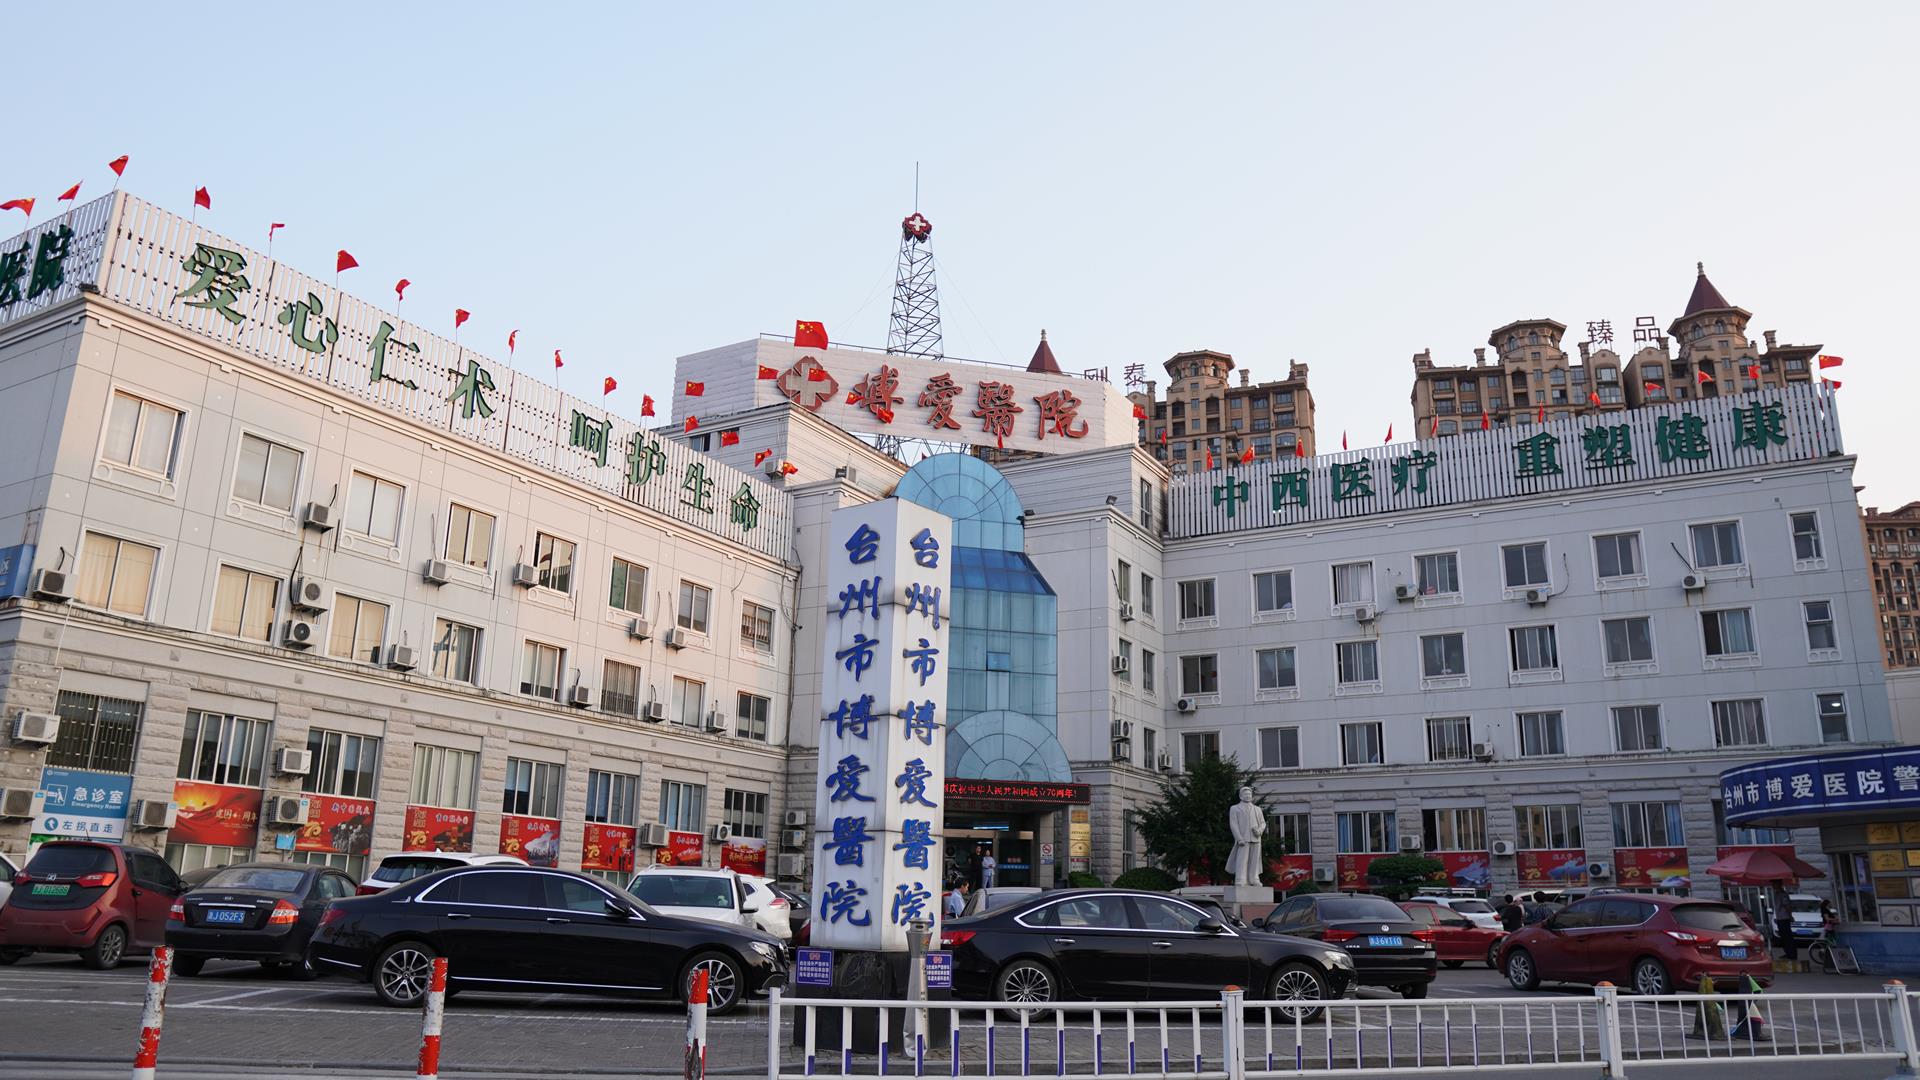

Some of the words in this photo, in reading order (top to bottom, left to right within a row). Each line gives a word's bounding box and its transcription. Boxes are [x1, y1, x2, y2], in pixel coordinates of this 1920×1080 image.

[1586, 316, 1661, 344] 臻品
[176, 242, 496, 419] 爱心仁术
[569, 409, 761, 532] 呵护生命
[1213, 449, 1437, 518] 中西医疗
[1513, 401, 1788, 476] 重塑健康
[73, 786, 124, 804] 急诊室
[1724, 765, 1920, 809] 台州市博爱医院警
[71, 801, 104, 809] Emergency
[62, 820, 113, 833] 左拐直走
